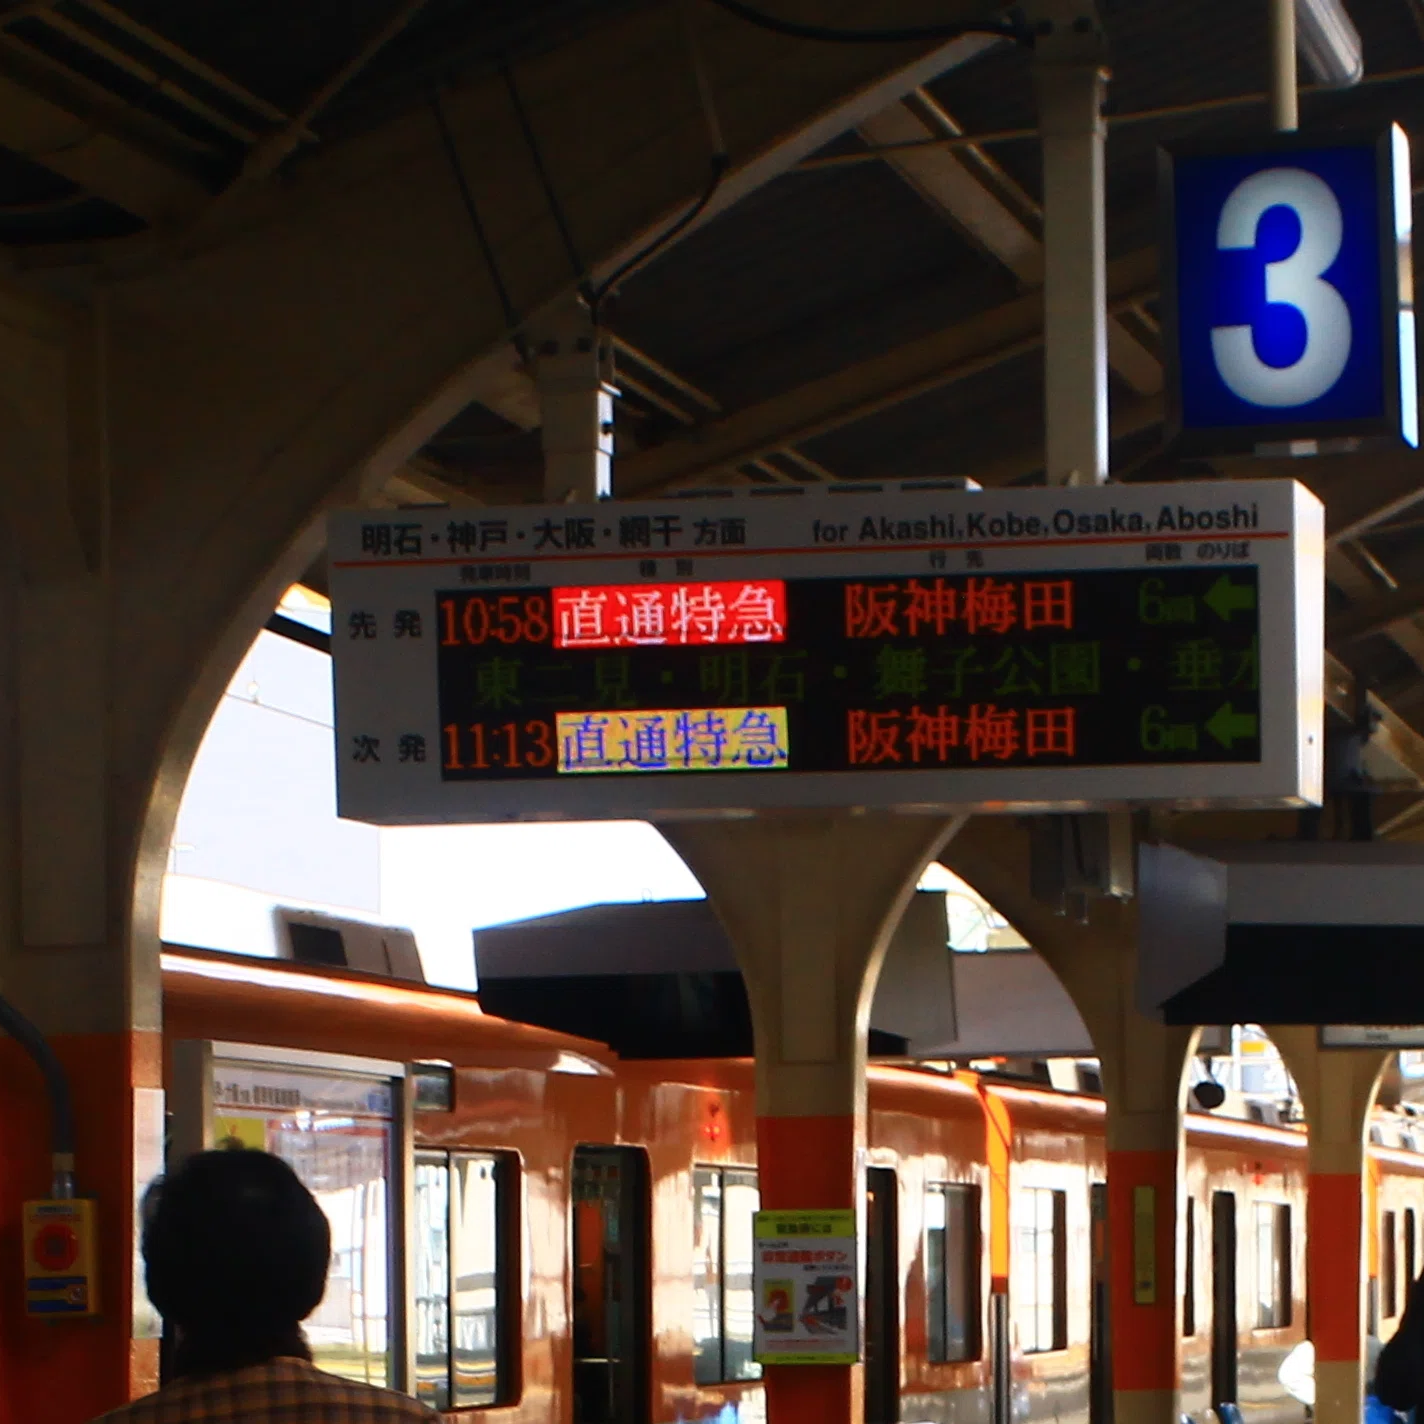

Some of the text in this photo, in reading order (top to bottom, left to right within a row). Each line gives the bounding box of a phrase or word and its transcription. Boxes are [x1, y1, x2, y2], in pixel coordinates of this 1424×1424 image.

[1210, 167, 1352, 407] 3
[813, 520, 849, 543] for
[440, 596, 548, 647] 10:58
[557, 583, 784, 647] 直通特急
[844, 577, 1074, 638] 阪神梅田
[443, 720, 554, 770] 11:13
[562, 710, 787, 771] 直通特急
[848, 704, 1075, 764] 阪神梅田
